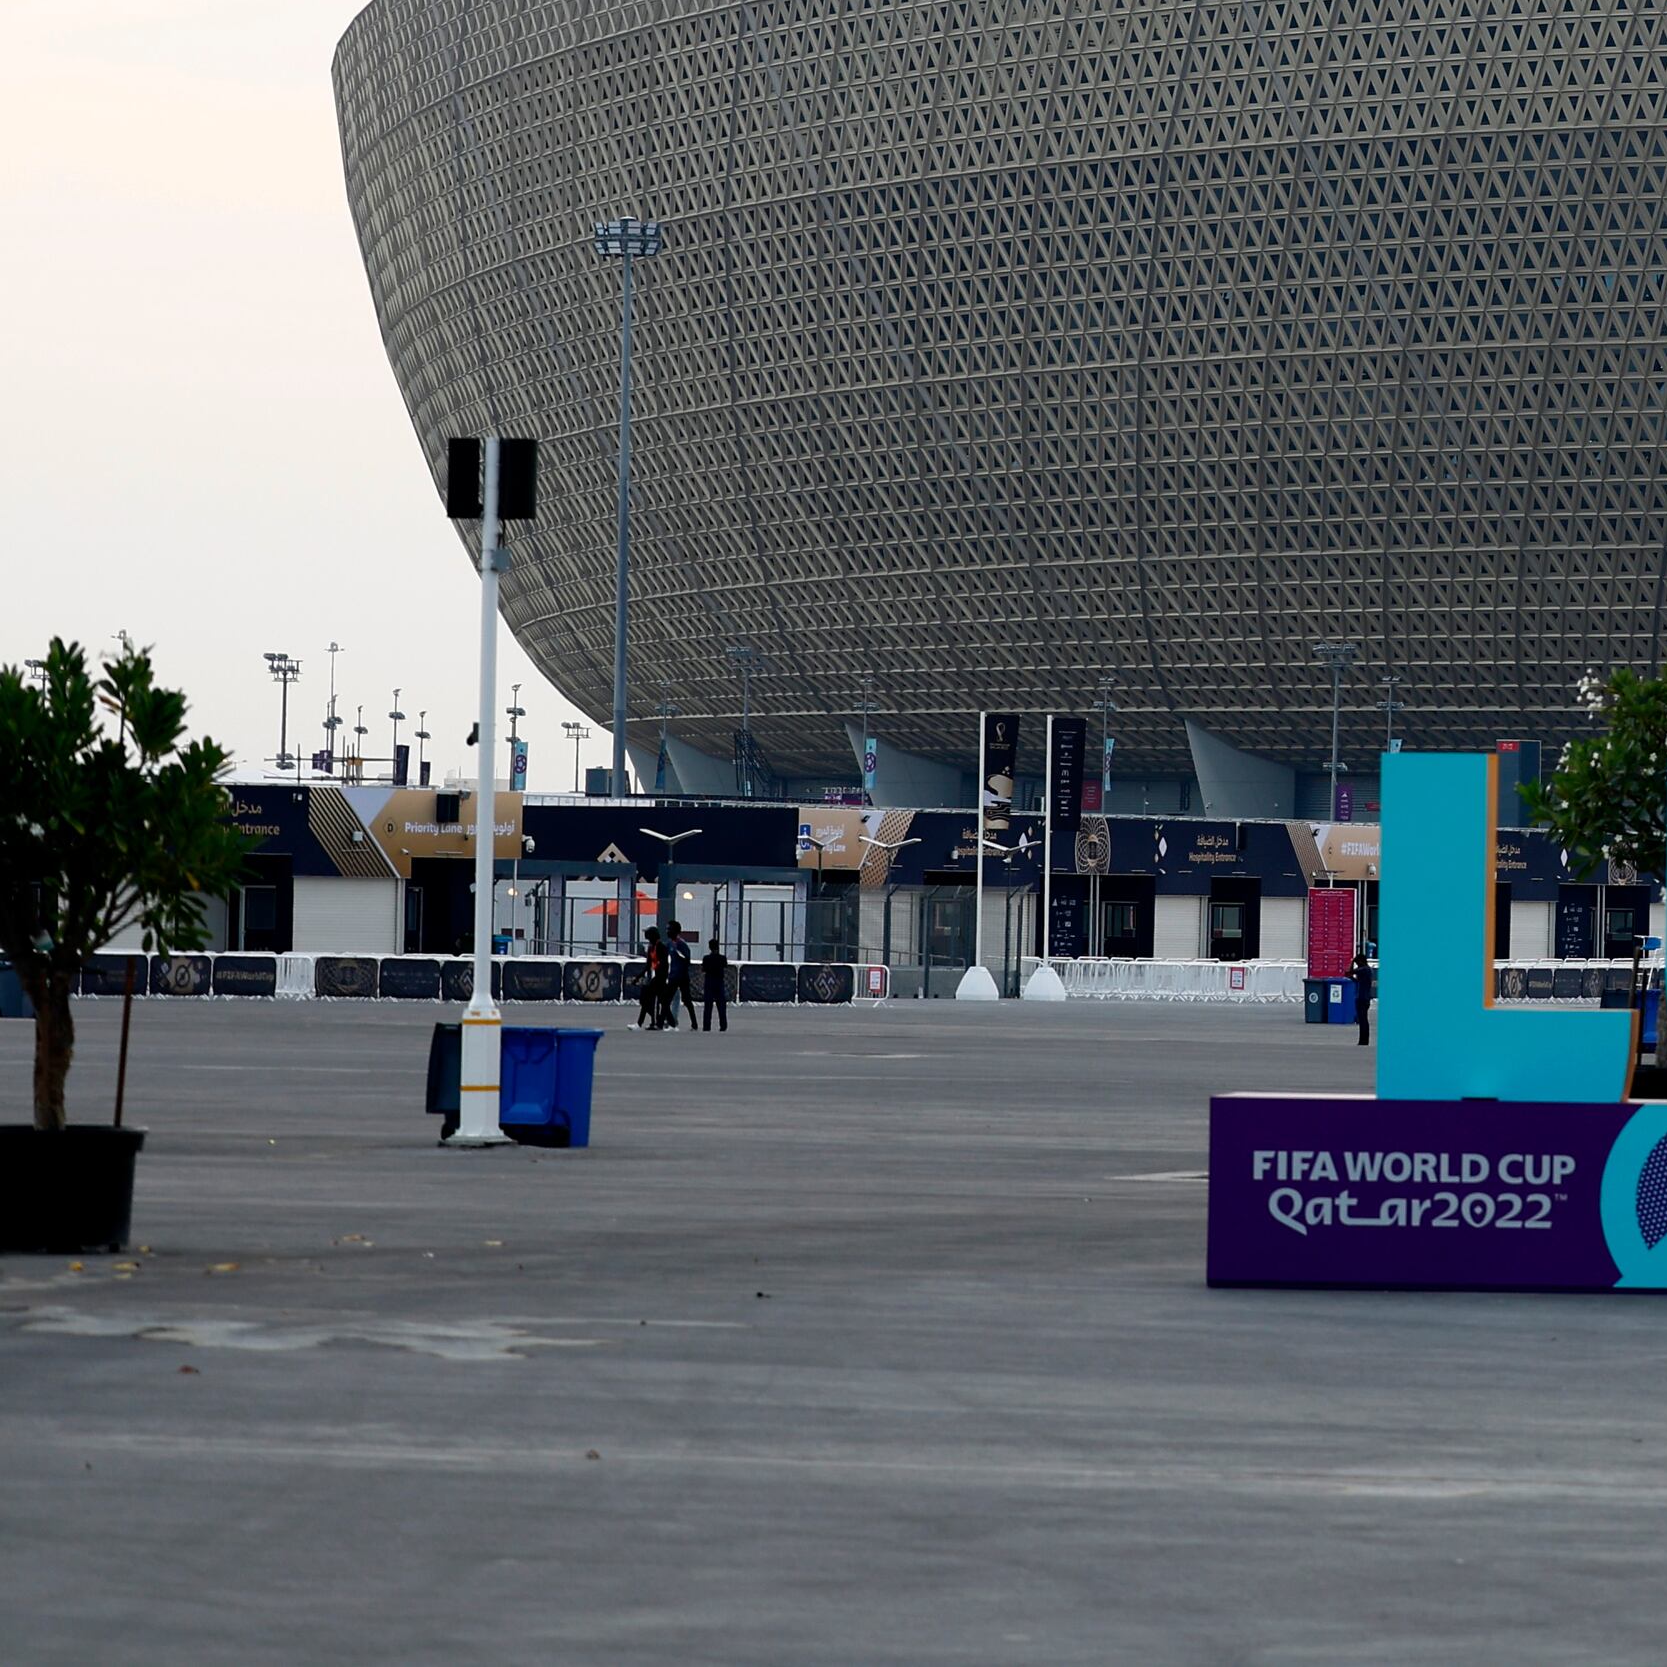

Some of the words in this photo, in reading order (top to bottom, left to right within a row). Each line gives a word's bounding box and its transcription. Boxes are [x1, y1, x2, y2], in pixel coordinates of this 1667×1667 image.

[404, 821, 440, 836] Priority
[441, 822, 463, 834] Lane
[1253, 1151, 1339, 1181] FIFA
[1344, 1152, 1490, 1183] WORLD
[1498, 1154, 1576, 1184] CUP
